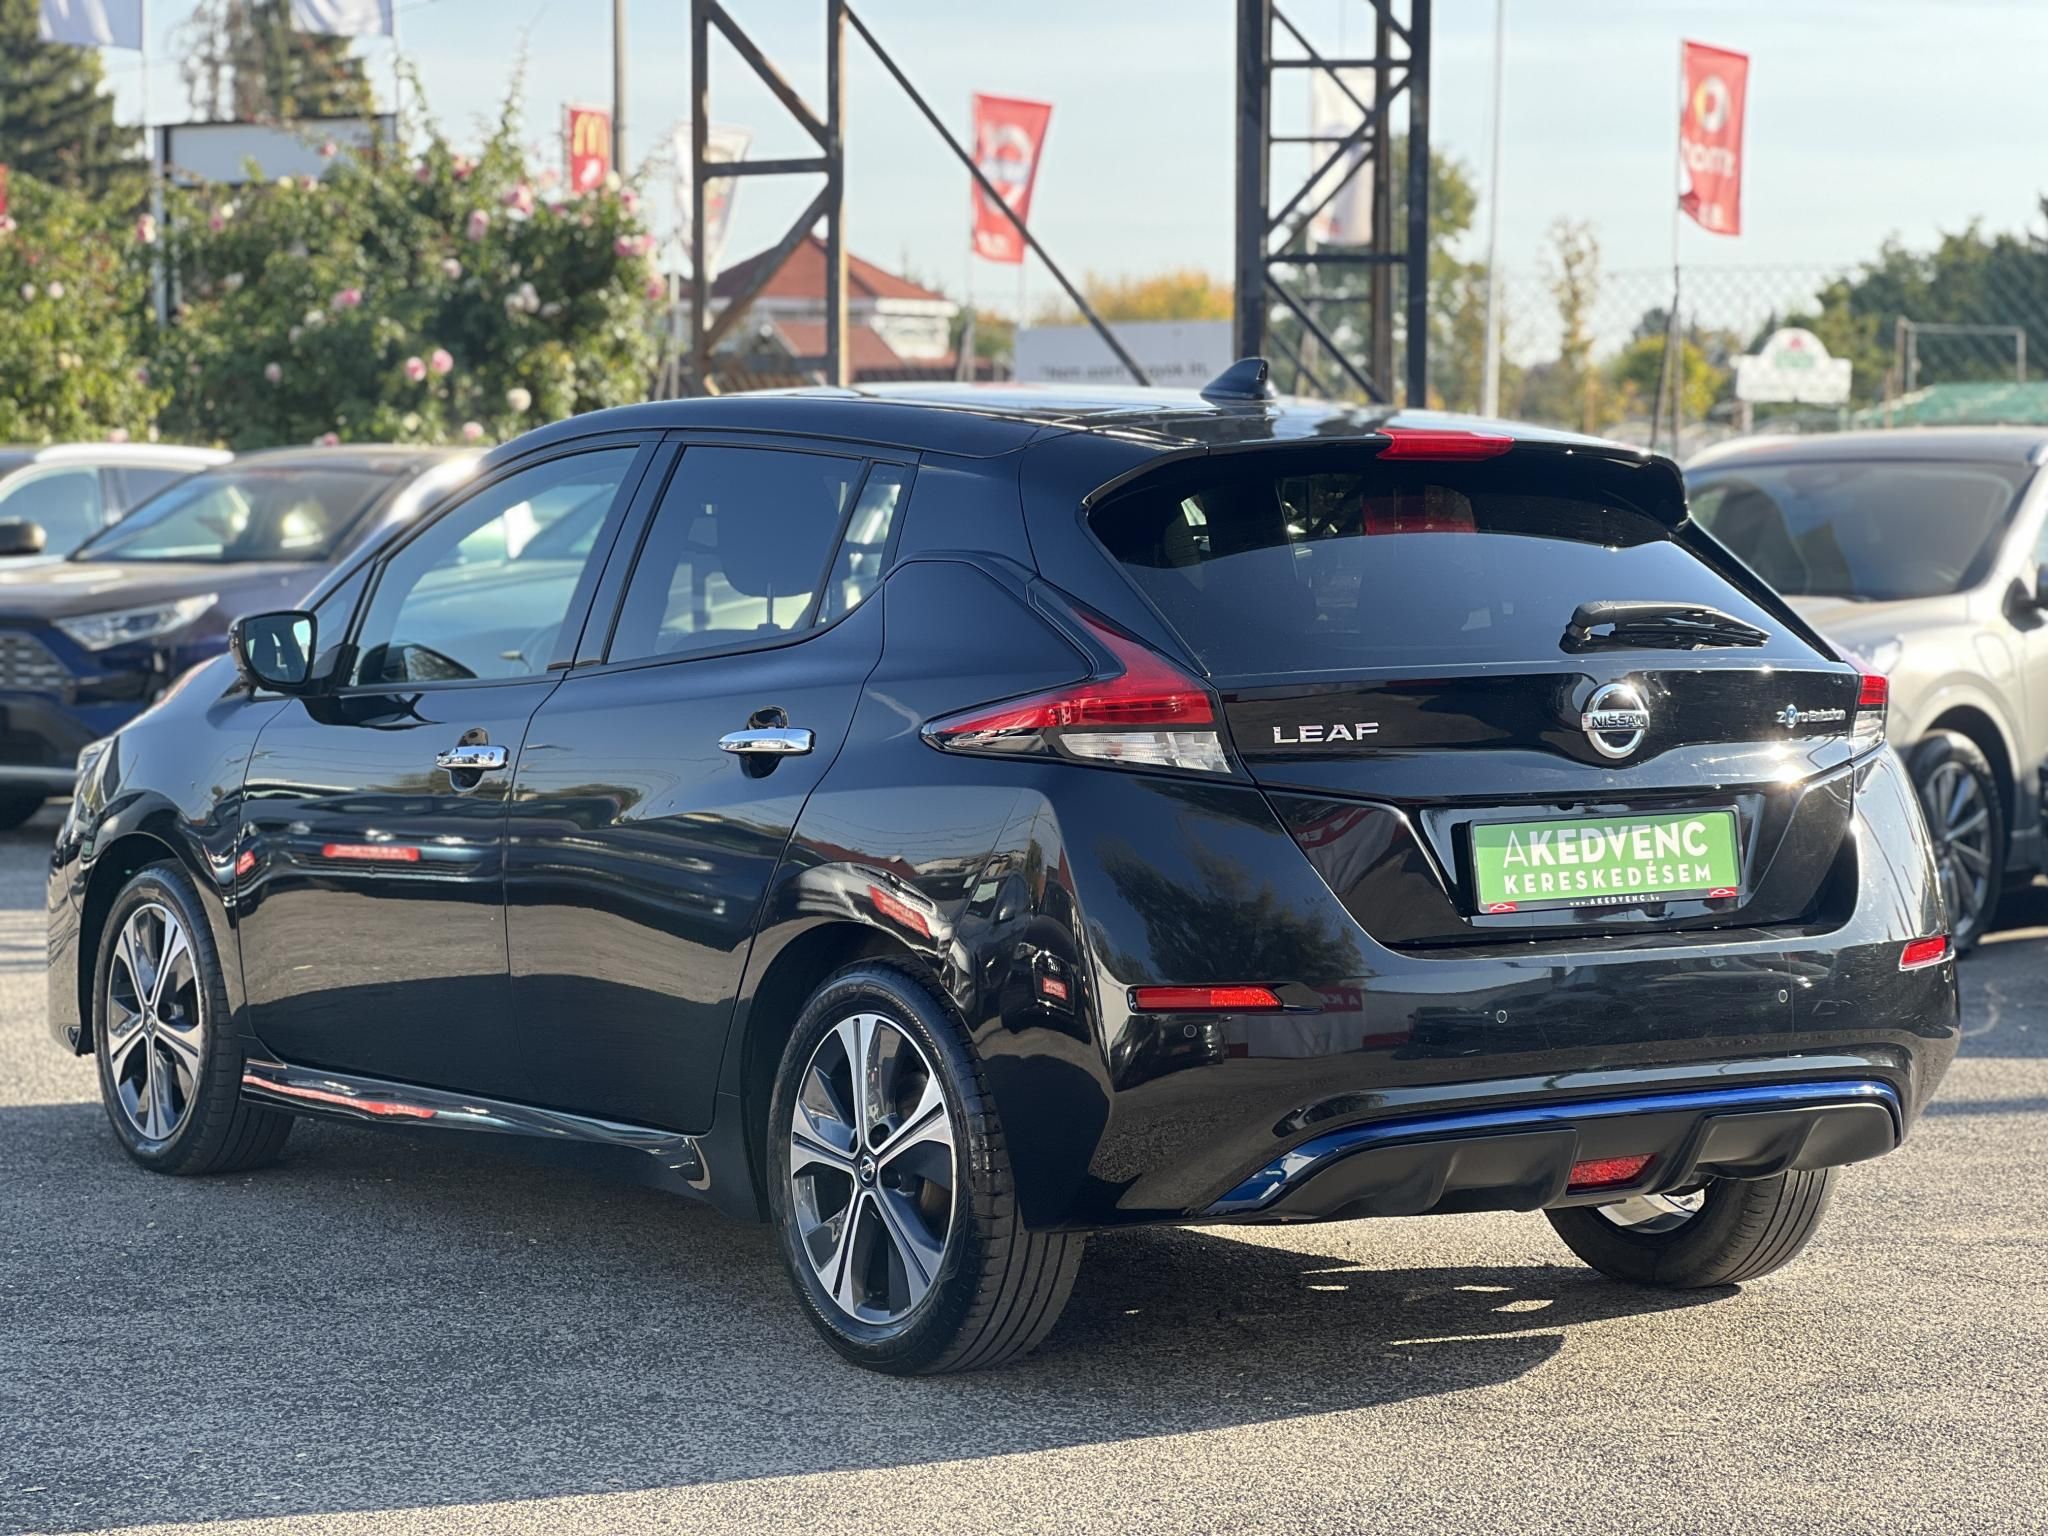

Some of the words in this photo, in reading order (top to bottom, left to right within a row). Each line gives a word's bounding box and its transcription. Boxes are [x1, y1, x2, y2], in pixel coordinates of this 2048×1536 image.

[1273, 722, 1379, 743] LEAF
[1591, 714, 1645, 729] NISSAN
[1503, 821, 1708, 868] AKEDVENC
[1503, 860, 1712, 895] KERESKEDÉSEM
